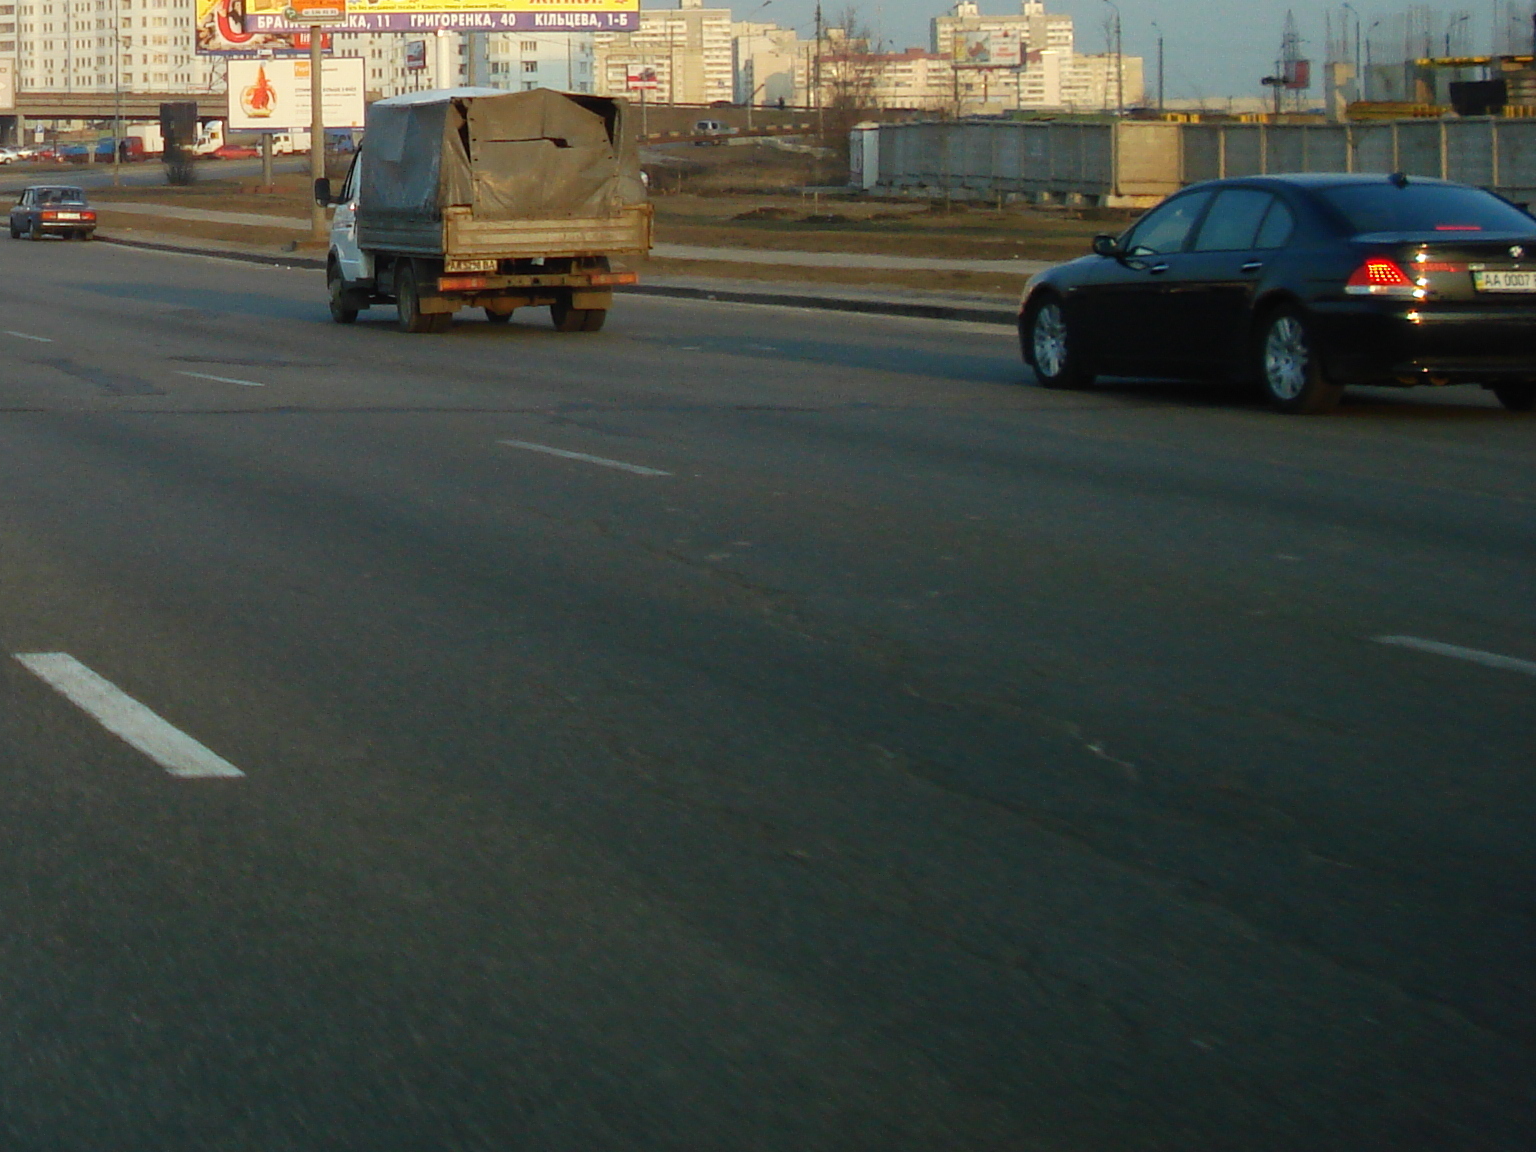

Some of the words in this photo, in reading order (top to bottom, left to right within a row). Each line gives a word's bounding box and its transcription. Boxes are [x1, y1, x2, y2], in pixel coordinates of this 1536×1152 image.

[376, 15, 391, 27] 11
[410, 14, 496, 28] ГРИГОРЕНКА,
[500, 13, 516, 26] 40
[534, 13, 602, 27] КІЛЬЦЕВА,
[607, 13, 628, 26] 1-Б
[1485, 274, 1501, 285] AA
[1505, 273, 1530, 285] 0007
